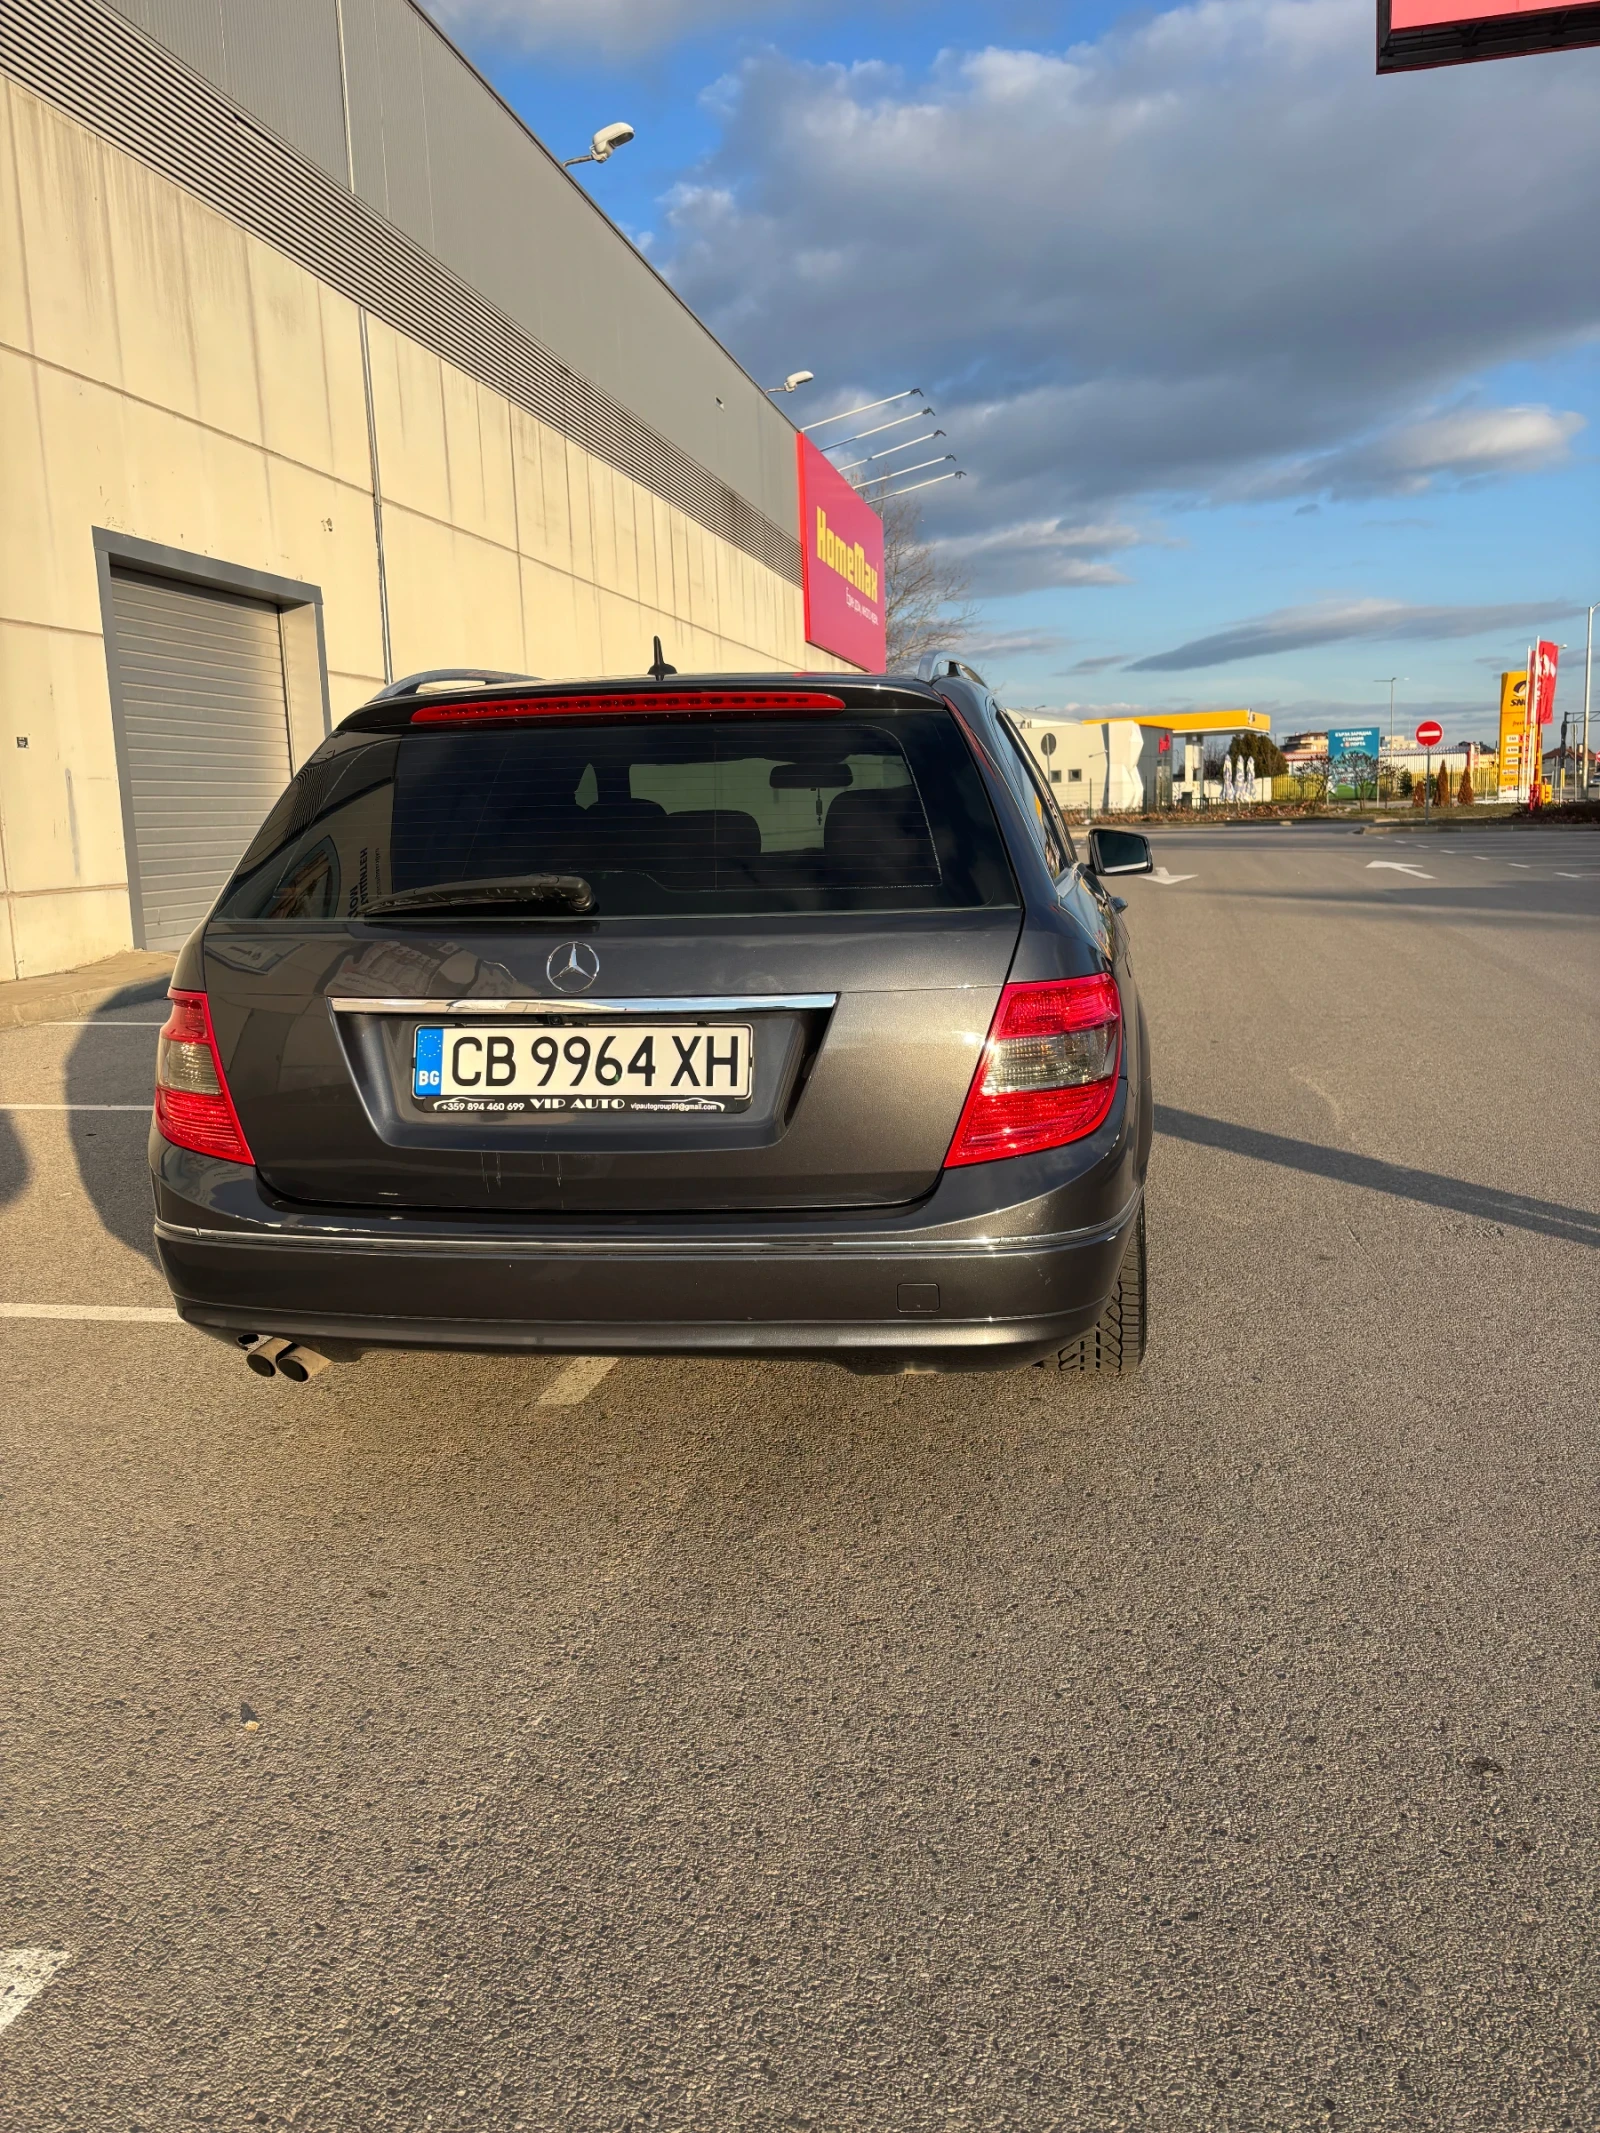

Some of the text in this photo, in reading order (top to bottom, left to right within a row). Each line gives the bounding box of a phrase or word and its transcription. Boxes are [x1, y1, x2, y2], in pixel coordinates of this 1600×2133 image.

[816, 505, 878, 605] HomeMax
[452, 1035, 739, 1087] CB 9964 XH
[418, 1071, 440, 1086] BG
[441, 1103, 525, 1111] +359 894 460 699
[529, 1098, 625, 1109] VIP AUTO
